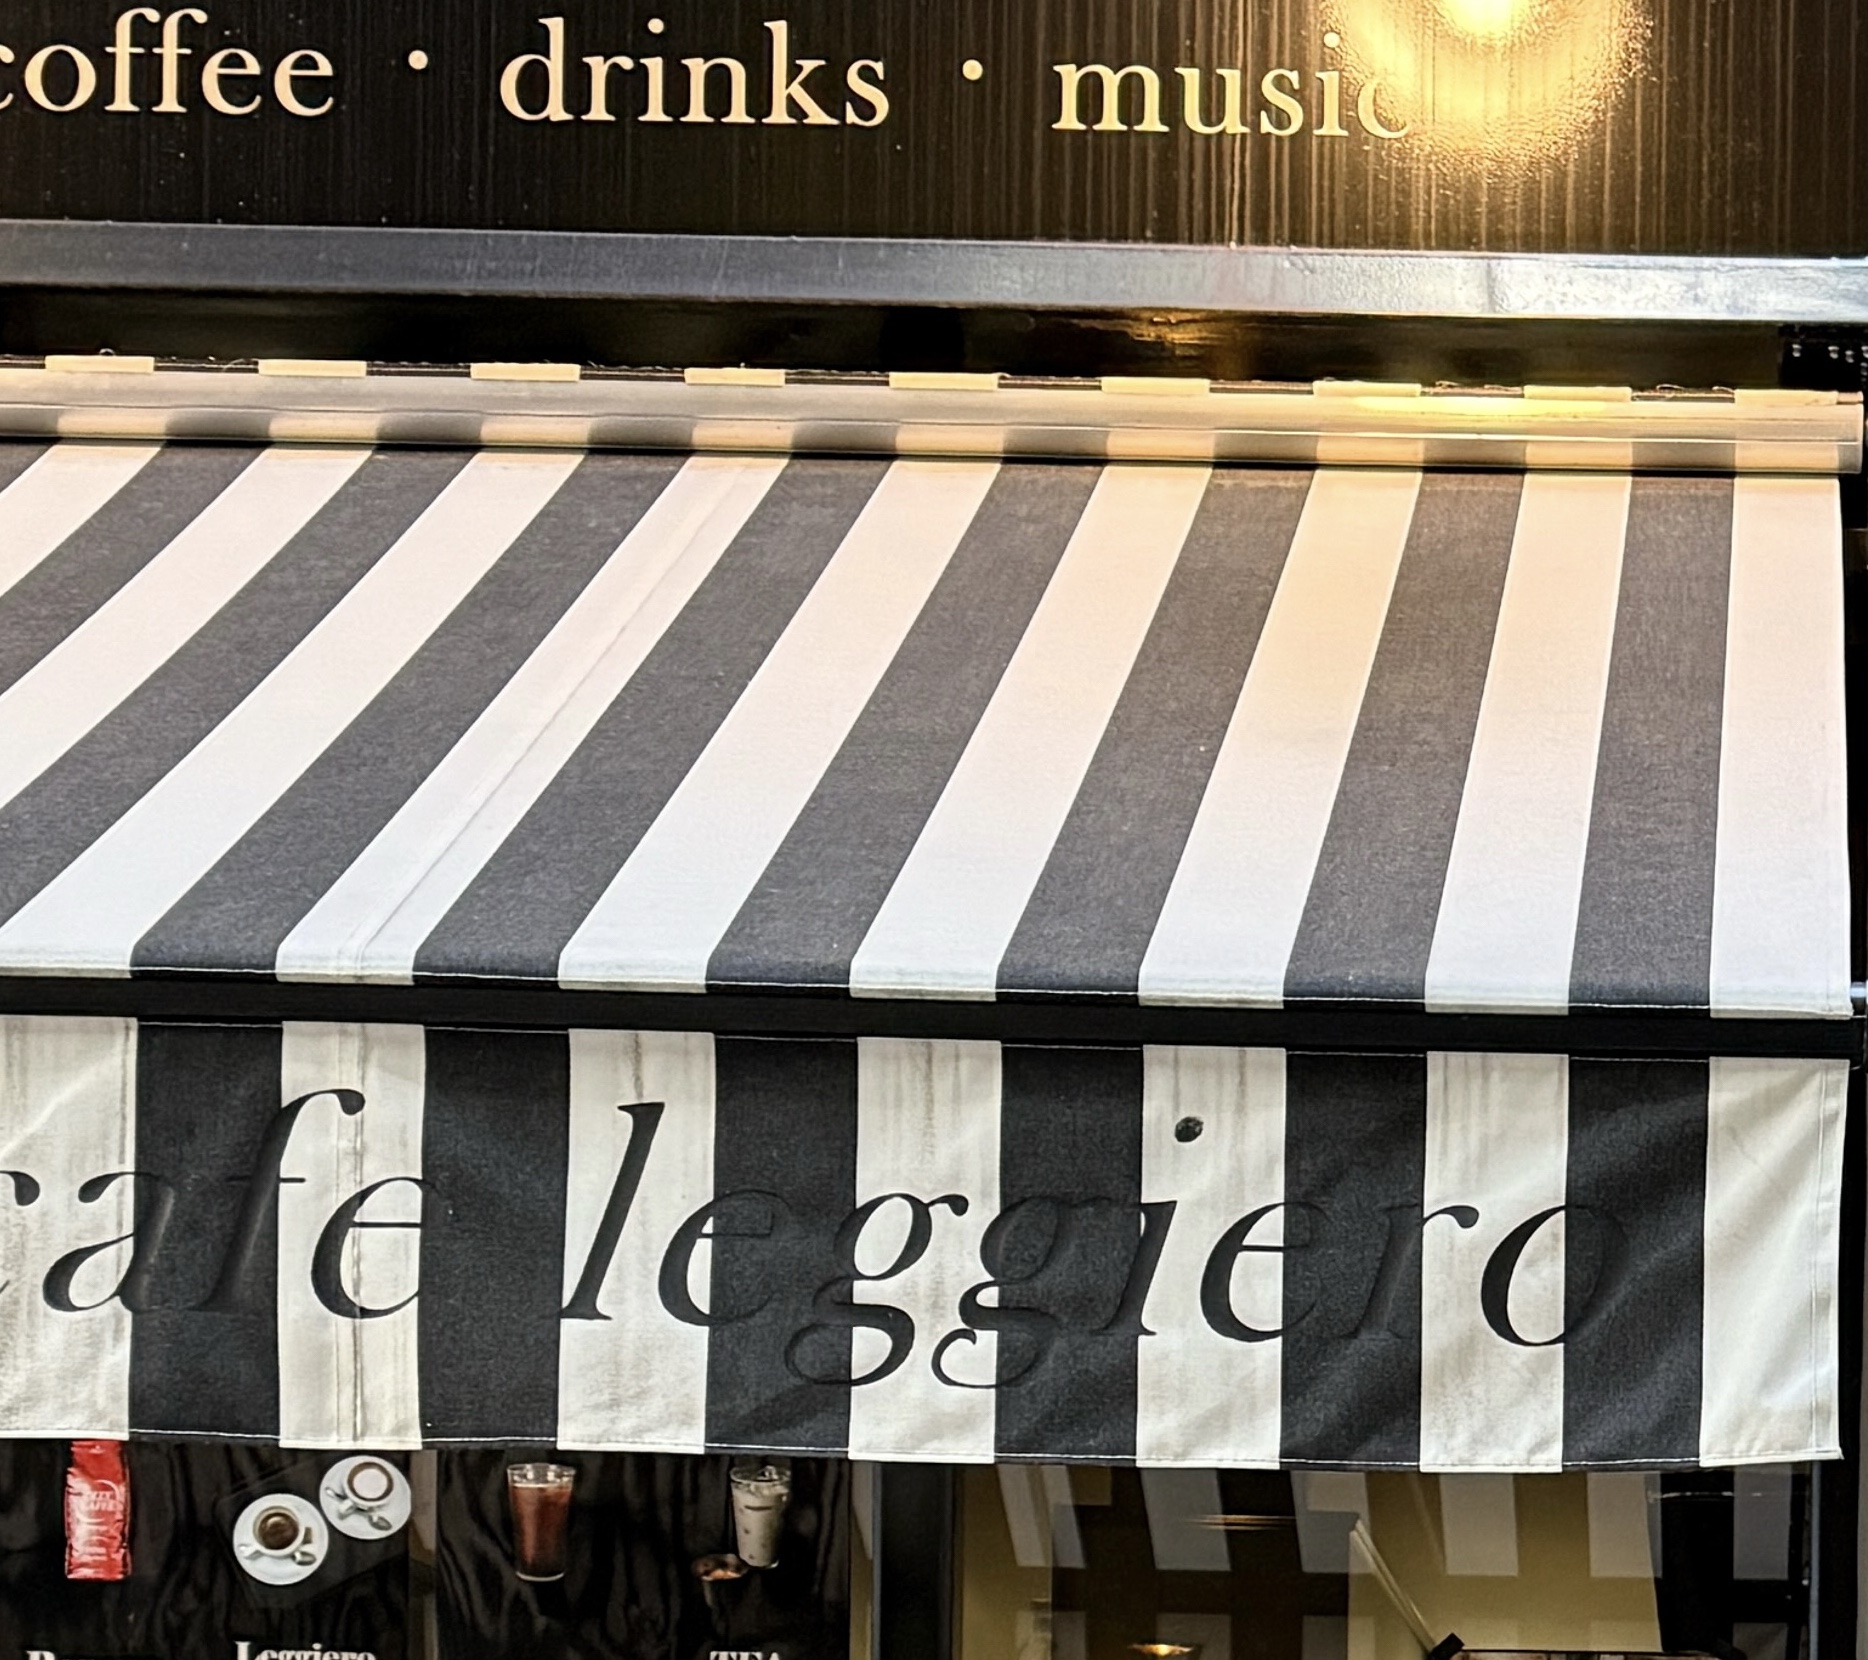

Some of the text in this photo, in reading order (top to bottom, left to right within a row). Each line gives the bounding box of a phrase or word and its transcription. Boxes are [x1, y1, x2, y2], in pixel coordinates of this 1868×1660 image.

[0, 7, 1410, 139] offee drinks music
[560, 1100, 1630, 1388] leggiero
